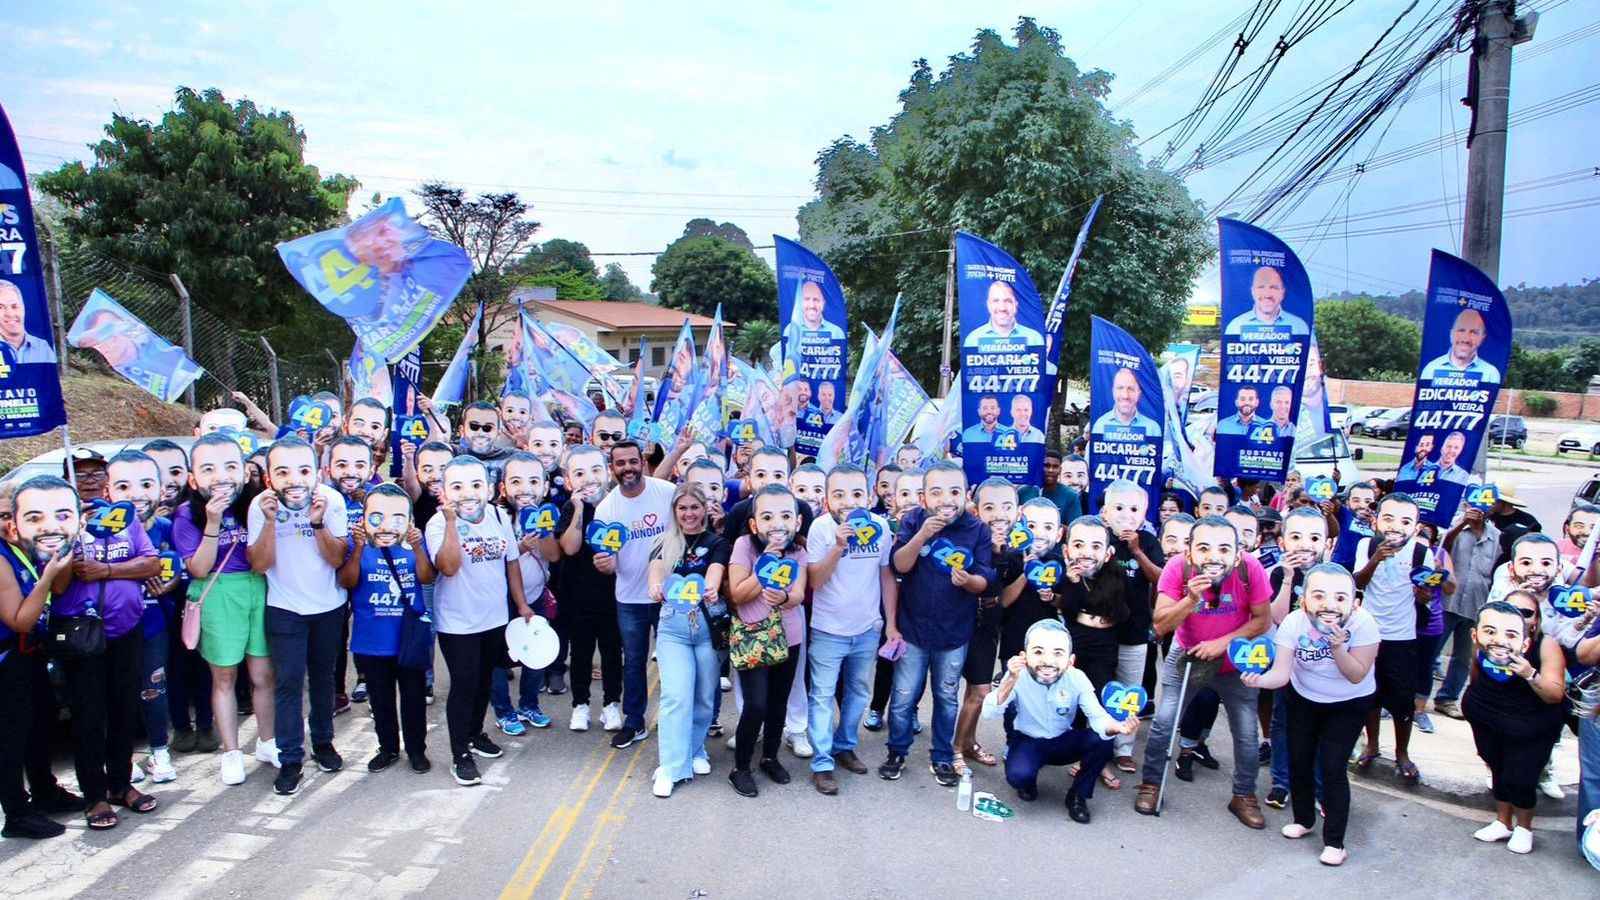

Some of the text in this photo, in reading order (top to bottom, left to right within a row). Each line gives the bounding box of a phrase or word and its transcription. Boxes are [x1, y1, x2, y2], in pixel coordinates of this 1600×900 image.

[801, 346, 841, 356] CARLOS
[1226, 342, 1303, 356] EDICARLOS
[966, 353, 1039, 366] EDICARLOS
[1268, 356, 1300, 365] VIEIRA
[800, 363, 841, 380] 4777
[1006, 366, 1039, 374] VIEIRA
[1227, 365, 1300, 385] 44777
[968, 375, 1040, 393] 44777
[1434, 377, 1479, 387] VEREADOR
[1418, 388, 1490, 403] EDICARLOS
[292, 403, 323, 430] 44
[1452, 402, 1485, 412] VIEIRA
[400, 420, 428, 439] 44
[1413, 410, 1484, 431] 44777
[731, 423, 756, 443] 44
[1093, 442, 1157, 457] EDICARLOS
[1124, 457, 1156, 466] VIEIRA
[1094, 463, 1156, 486] 44777
[1308, 481, 1332, 499] 44
[1467, 488, 1496, 506] 44
[88, 506, 127, 533] 44
[525, 510, 556, 532] 44
[591, 527, 622, 552] 44
[933, 546, 966, 570] 44
[758, 561, 792, 587] 44
[1027, 565, 1057, 586] 44
[667, 580, 702, 604] 44
[1553, 591, 1588, 612] 44
[1234, 644, 1270, 669] 44
[1106, 689, 1140, 716] 44
